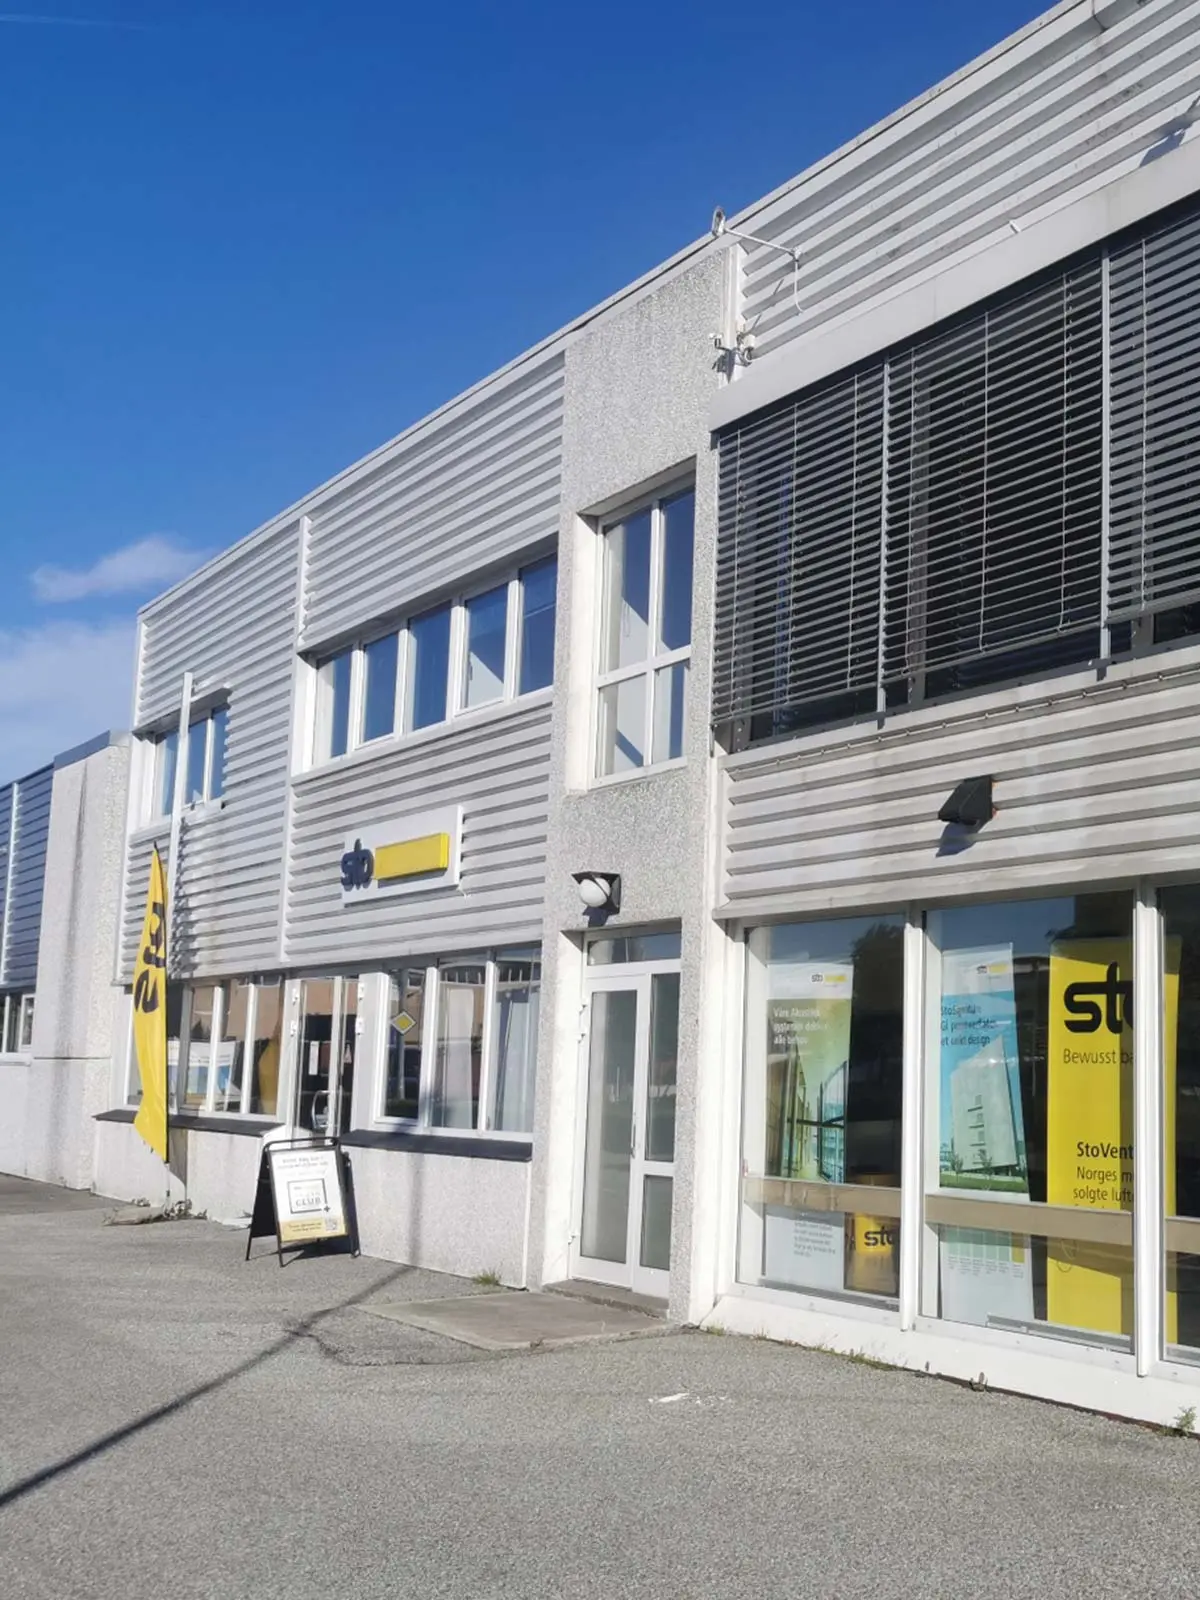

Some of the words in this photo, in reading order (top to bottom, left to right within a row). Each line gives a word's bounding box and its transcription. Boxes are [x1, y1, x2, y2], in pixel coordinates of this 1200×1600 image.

[341, 838, 374, 888] sto
[1063, 1048, 1117, 1064] Bewusst
[1077, 1166, 1118, 1185] Norges
[1073, 1185, 1108, 1204] solgte
[1111, 1187, 1134, 1202] luft
